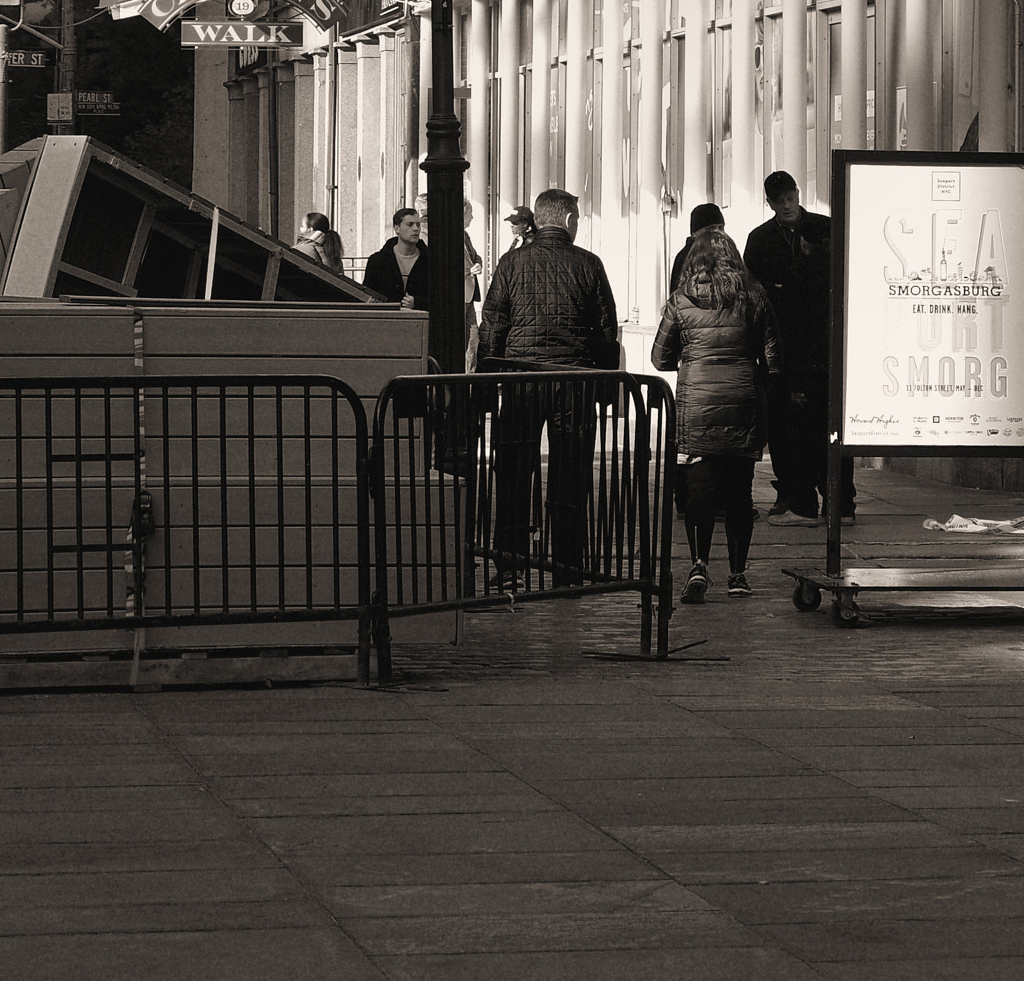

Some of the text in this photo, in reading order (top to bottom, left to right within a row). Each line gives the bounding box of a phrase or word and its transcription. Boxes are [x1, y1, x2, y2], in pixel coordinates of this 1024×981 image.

[236, 2, 250, 11] 19
[191, 24, 293, 43] WALK
[30, 52, 44, 65] ST
[78, 92, 112, 103] PEARL ST
[888, 284, 1002, 297] SMORGASBURG
[912, 304, 979, 315] EAT. DRINK. HANG.
[882, 355, 1009, 398] SMORG
[956, 384, 966, 392] MAY
